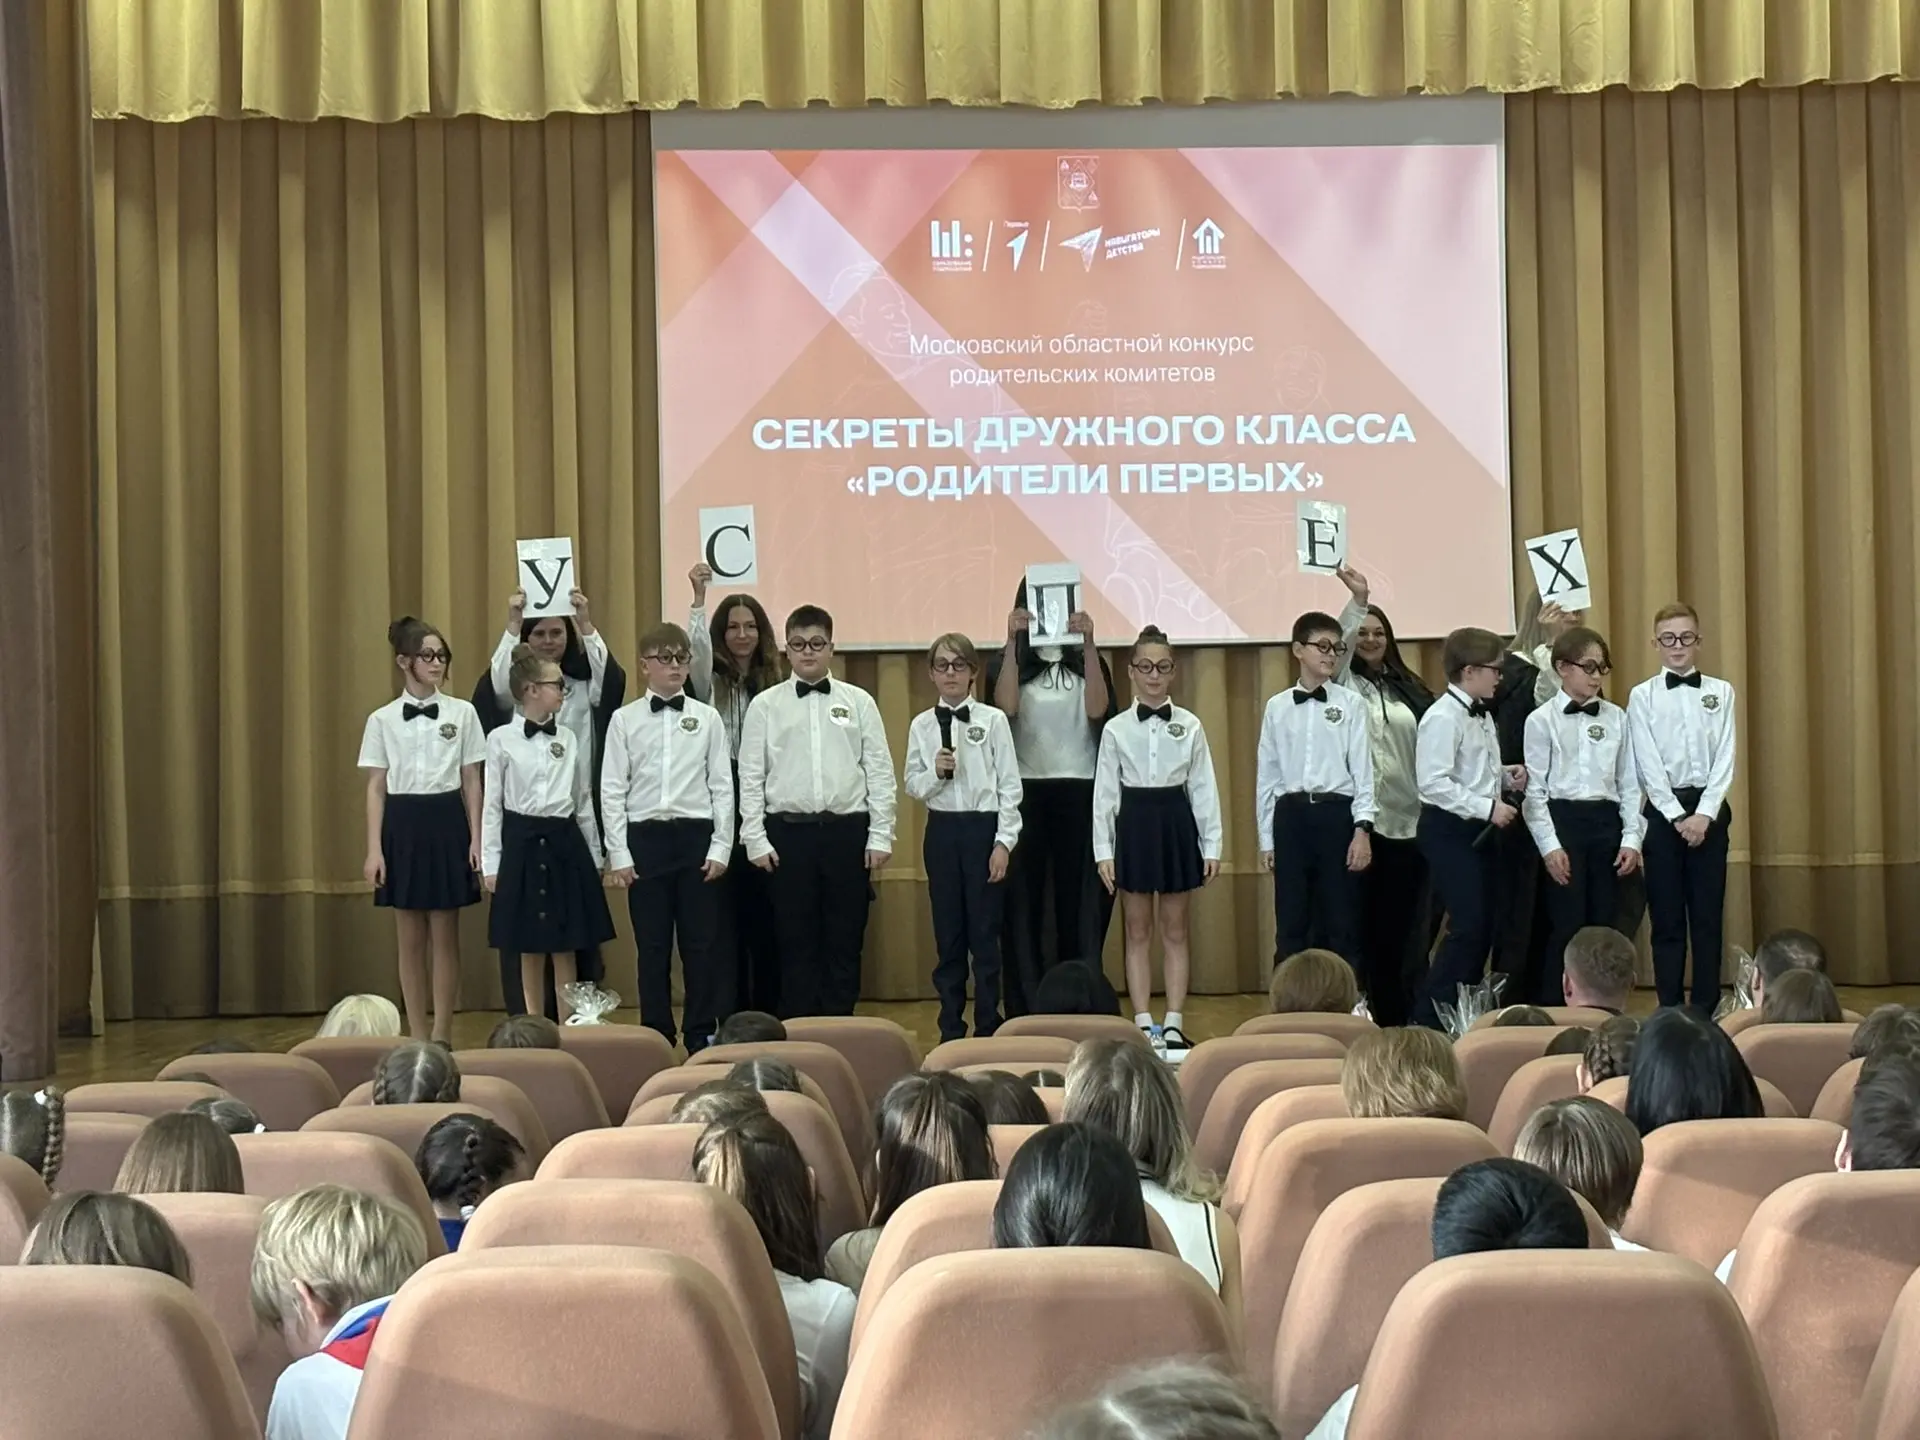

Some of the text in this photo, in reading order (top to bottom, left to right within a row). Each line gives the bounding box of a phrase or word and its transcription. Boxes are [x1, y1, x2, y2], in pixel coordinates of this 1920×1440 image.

[1105, 242, 1145, 260] ДЕТСТВА
[909, 333, 1254, 356] Московский областной конкурс
[950, 366, 1216, 387] родительских комитетов
[752, 413, 1417, 453] СЕКРЕТЫ ДРУЖНОГО КЛАССА
[847, 461, 1324, 501] «РОДИТЕЛИ ПЕРВЫХ»
[705, 524, 753, 578] С
[1301, 517, 1342, 569] Е
[1527, 537, 1587, 597] Х
